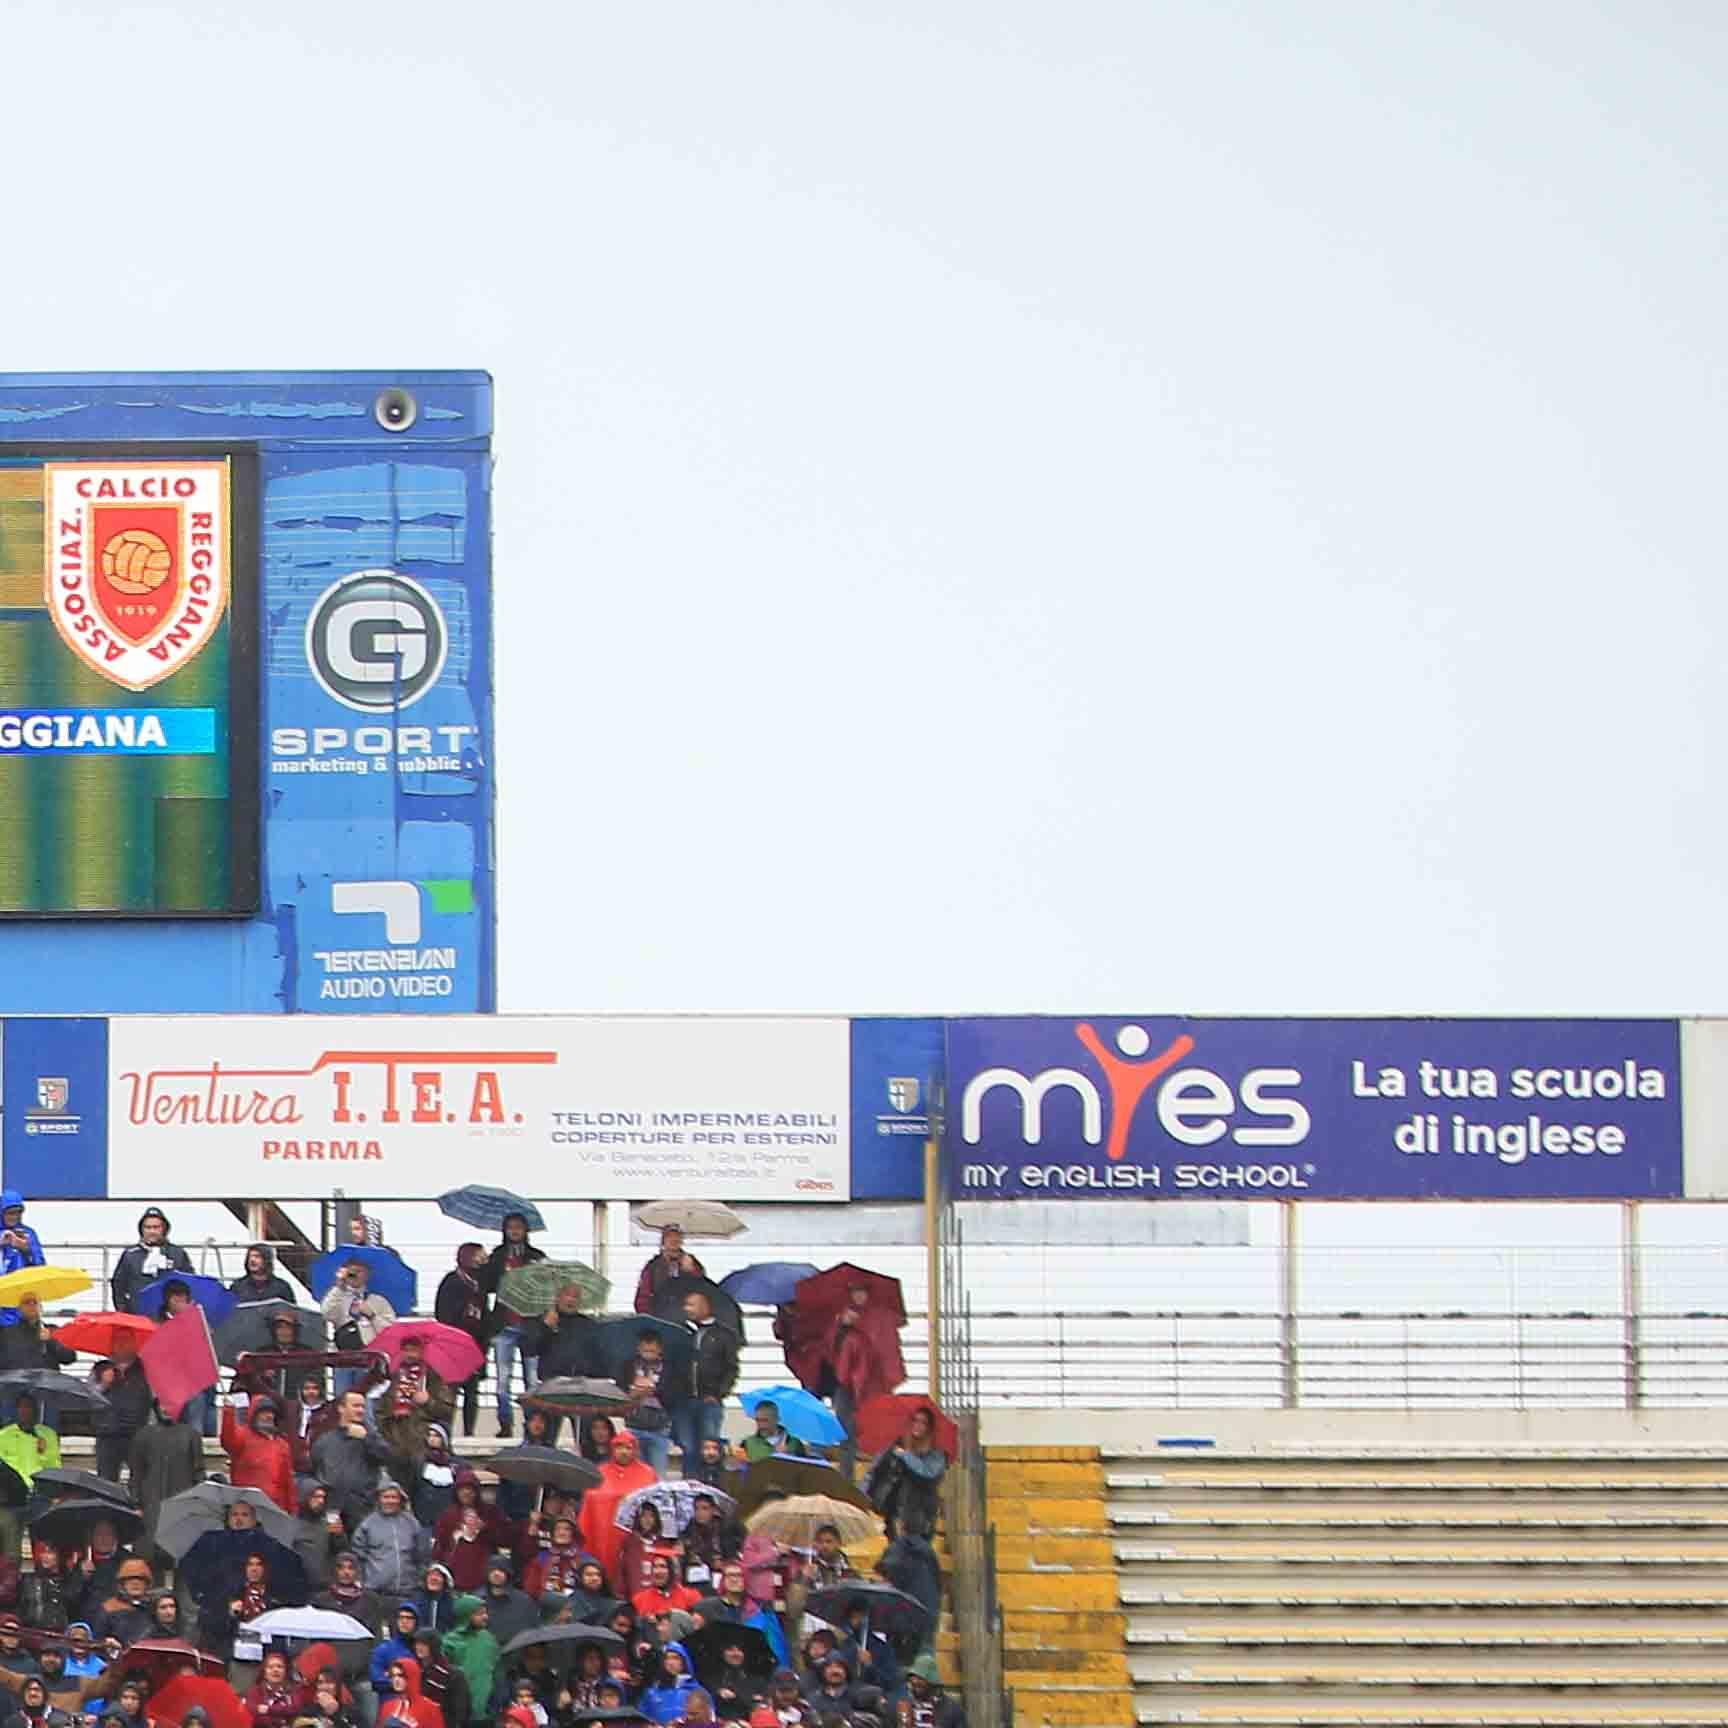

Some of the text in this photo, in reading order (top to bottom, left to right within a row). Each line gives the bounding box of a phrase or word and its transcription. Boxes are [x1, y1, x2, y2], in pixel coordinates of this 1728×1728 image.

[76, 477, 197, 498] CALCIO
[148, 512, 213, 661] REGGIANA
[272, 726, 473, 755] SPORT
[272, 757, 368, 774] marketing
[320, 976, 453, 999] AUDIO VIDEO
[1352, 1057, 1666, 1100] La tua scuola
[120, 1061, 305, 1125] Ventura
[552, 1111, 838, 1128] TELONI IMPERMEABILI
[552, 1130, 838, 1146] COPERTURE PER ESTERNI
[1394, 1112, 1627, 1165] di inglese
[263, 1140, 386, 1161] PARMA
[1175, 1164, 1307, 1188] SCHOOL
